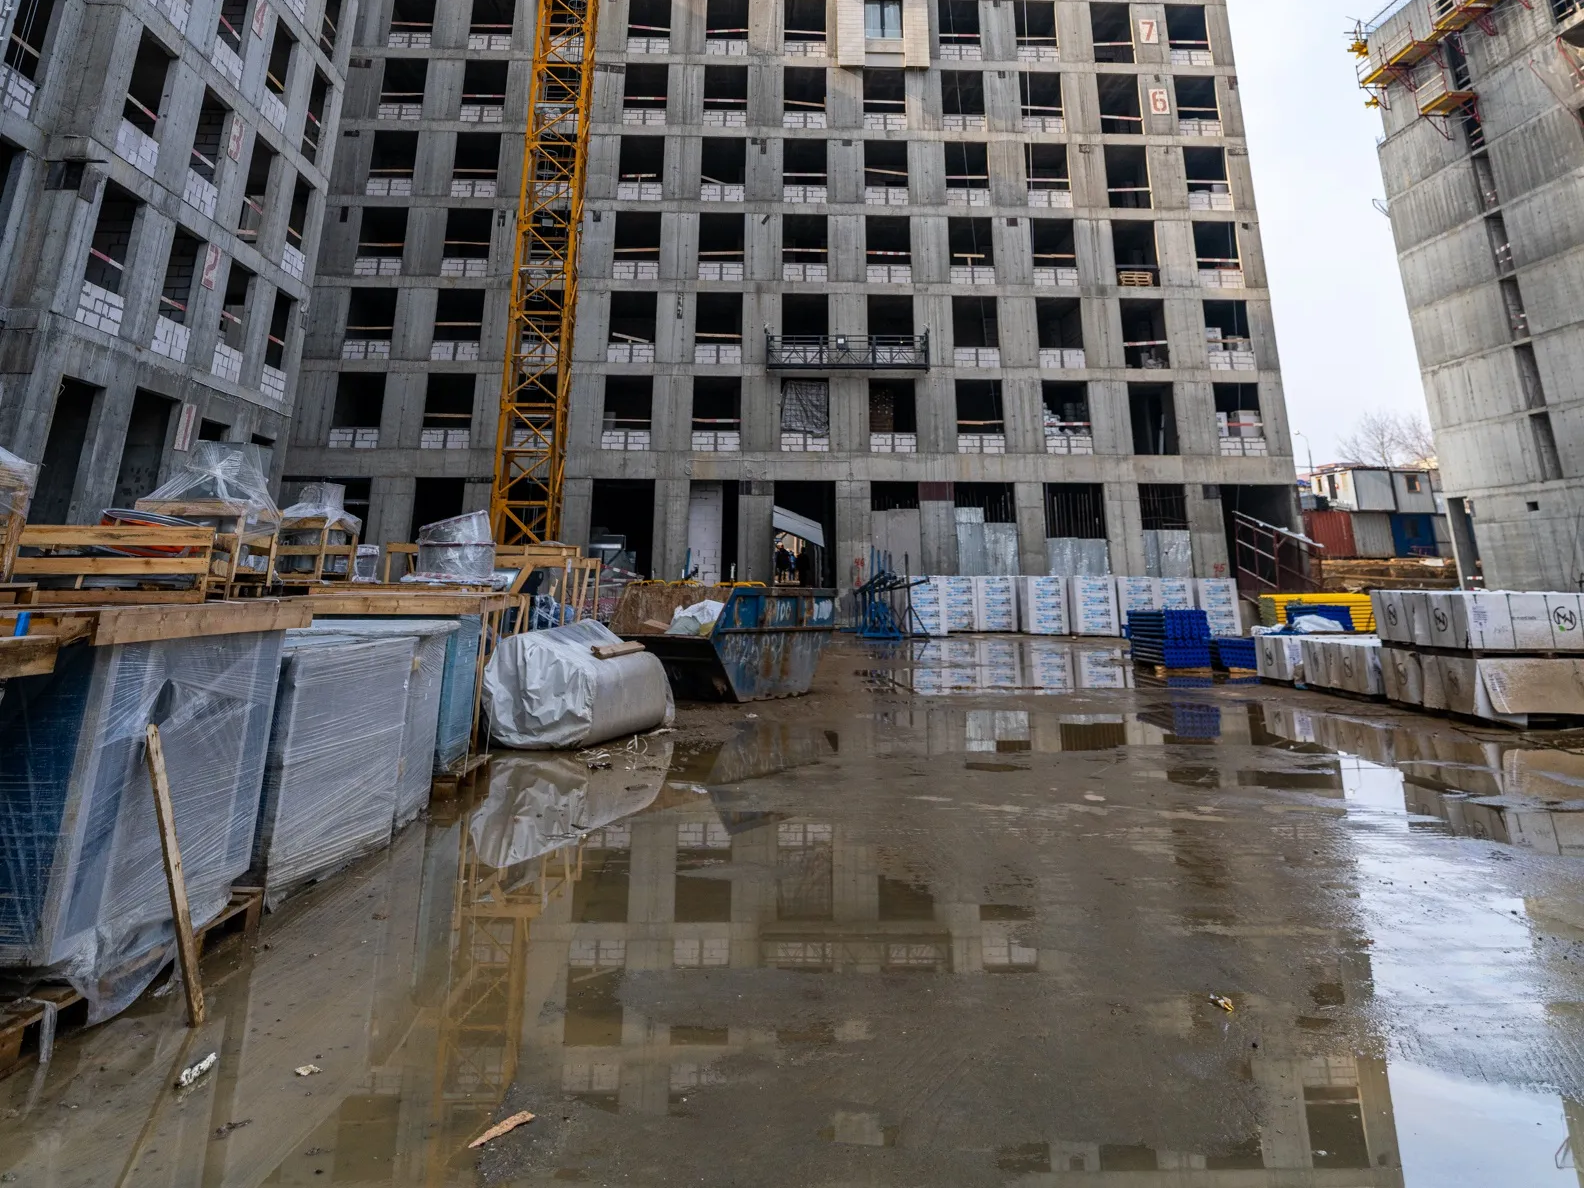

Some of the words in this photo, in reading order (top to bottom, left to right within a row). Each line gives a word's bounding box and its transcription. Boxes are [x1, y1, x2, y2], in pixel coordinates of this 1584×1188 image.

[1141, 22, 1154, 40] 7
[1152, 91, 1167, 111] 6
[228, 118, 244, 159] 3
[202, 243, 219, 288] 2
